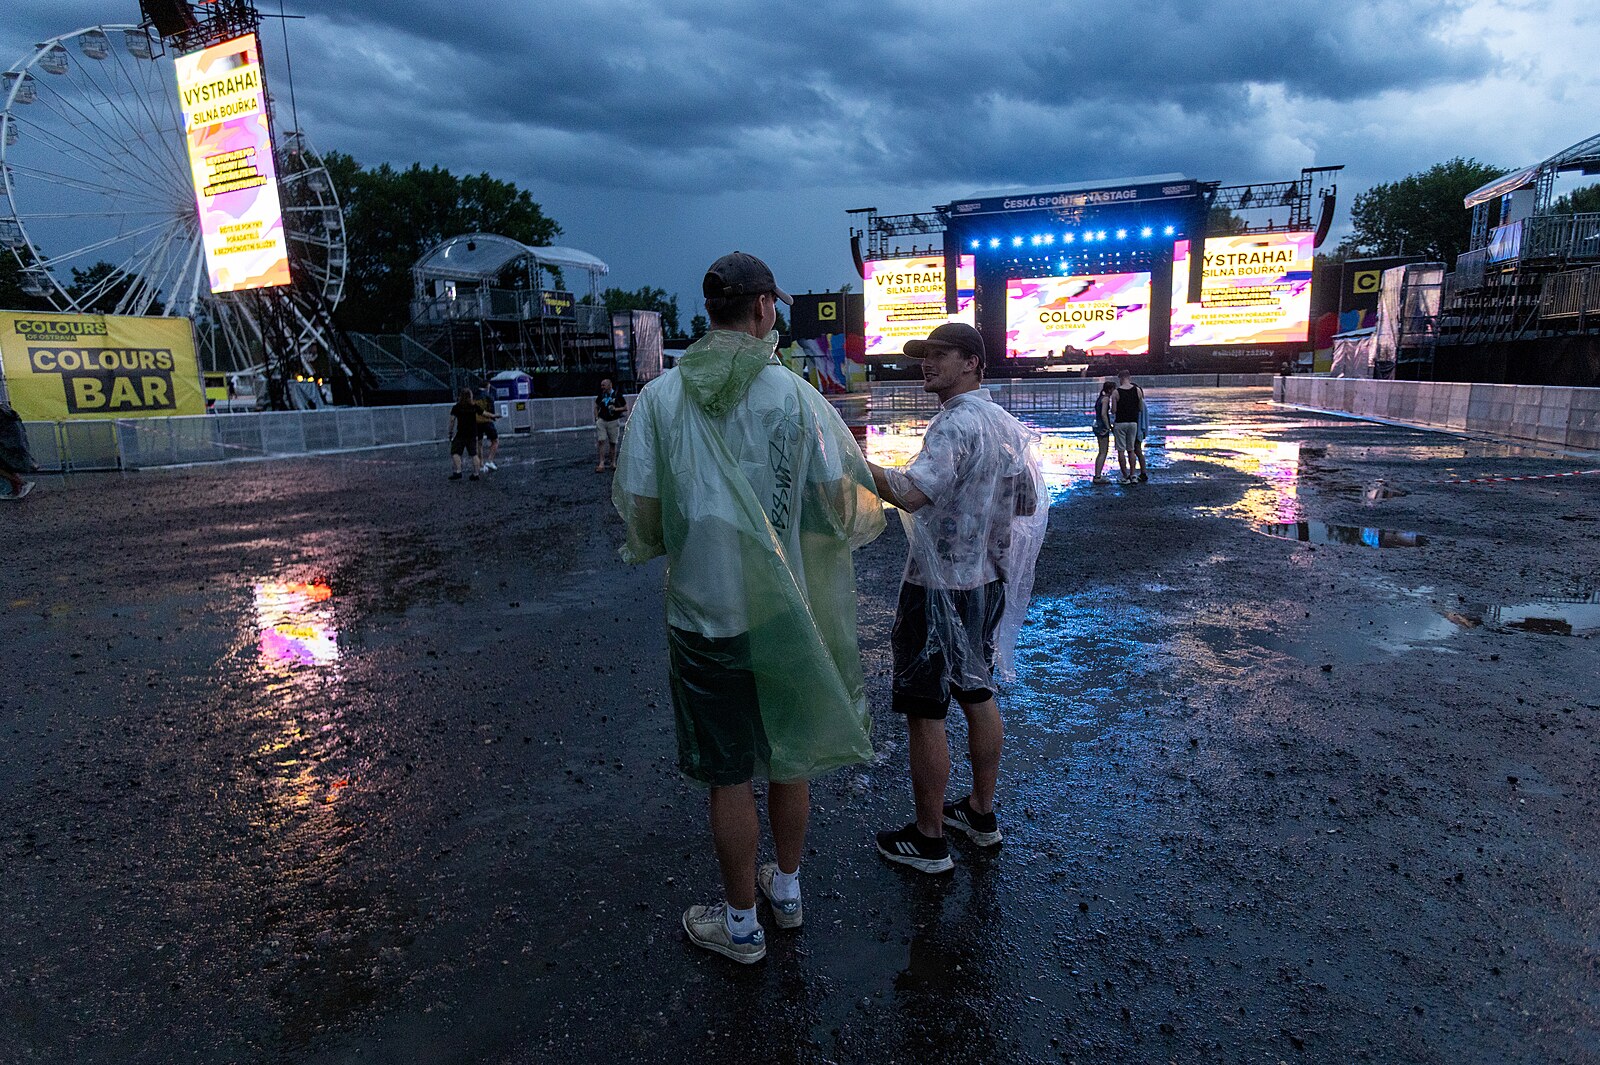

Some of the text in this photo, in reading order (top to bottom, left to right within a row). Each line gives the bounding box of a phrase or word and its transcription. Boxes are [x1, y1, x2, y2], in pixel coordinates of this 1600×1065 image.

[184, 71, 258, 106] VÝSTRAHA!
[193, 98, 258, 125] SILNÁ BOUŘKA
[1003, 190, 1137, 209] ČESKÁ SPOŘITNA STAGE
[1238, 264, 1285, 276] BOUŘKA
[1358, 274, 1376, 290] C
[821, 304, 833, 318] C
[1039, 309, 1115, 323] COLOURS
[16, 321, 106, 334] COLOURS
[33, 350, 172, 371] COLOURS
[72, 376, 170, 408] BAR
